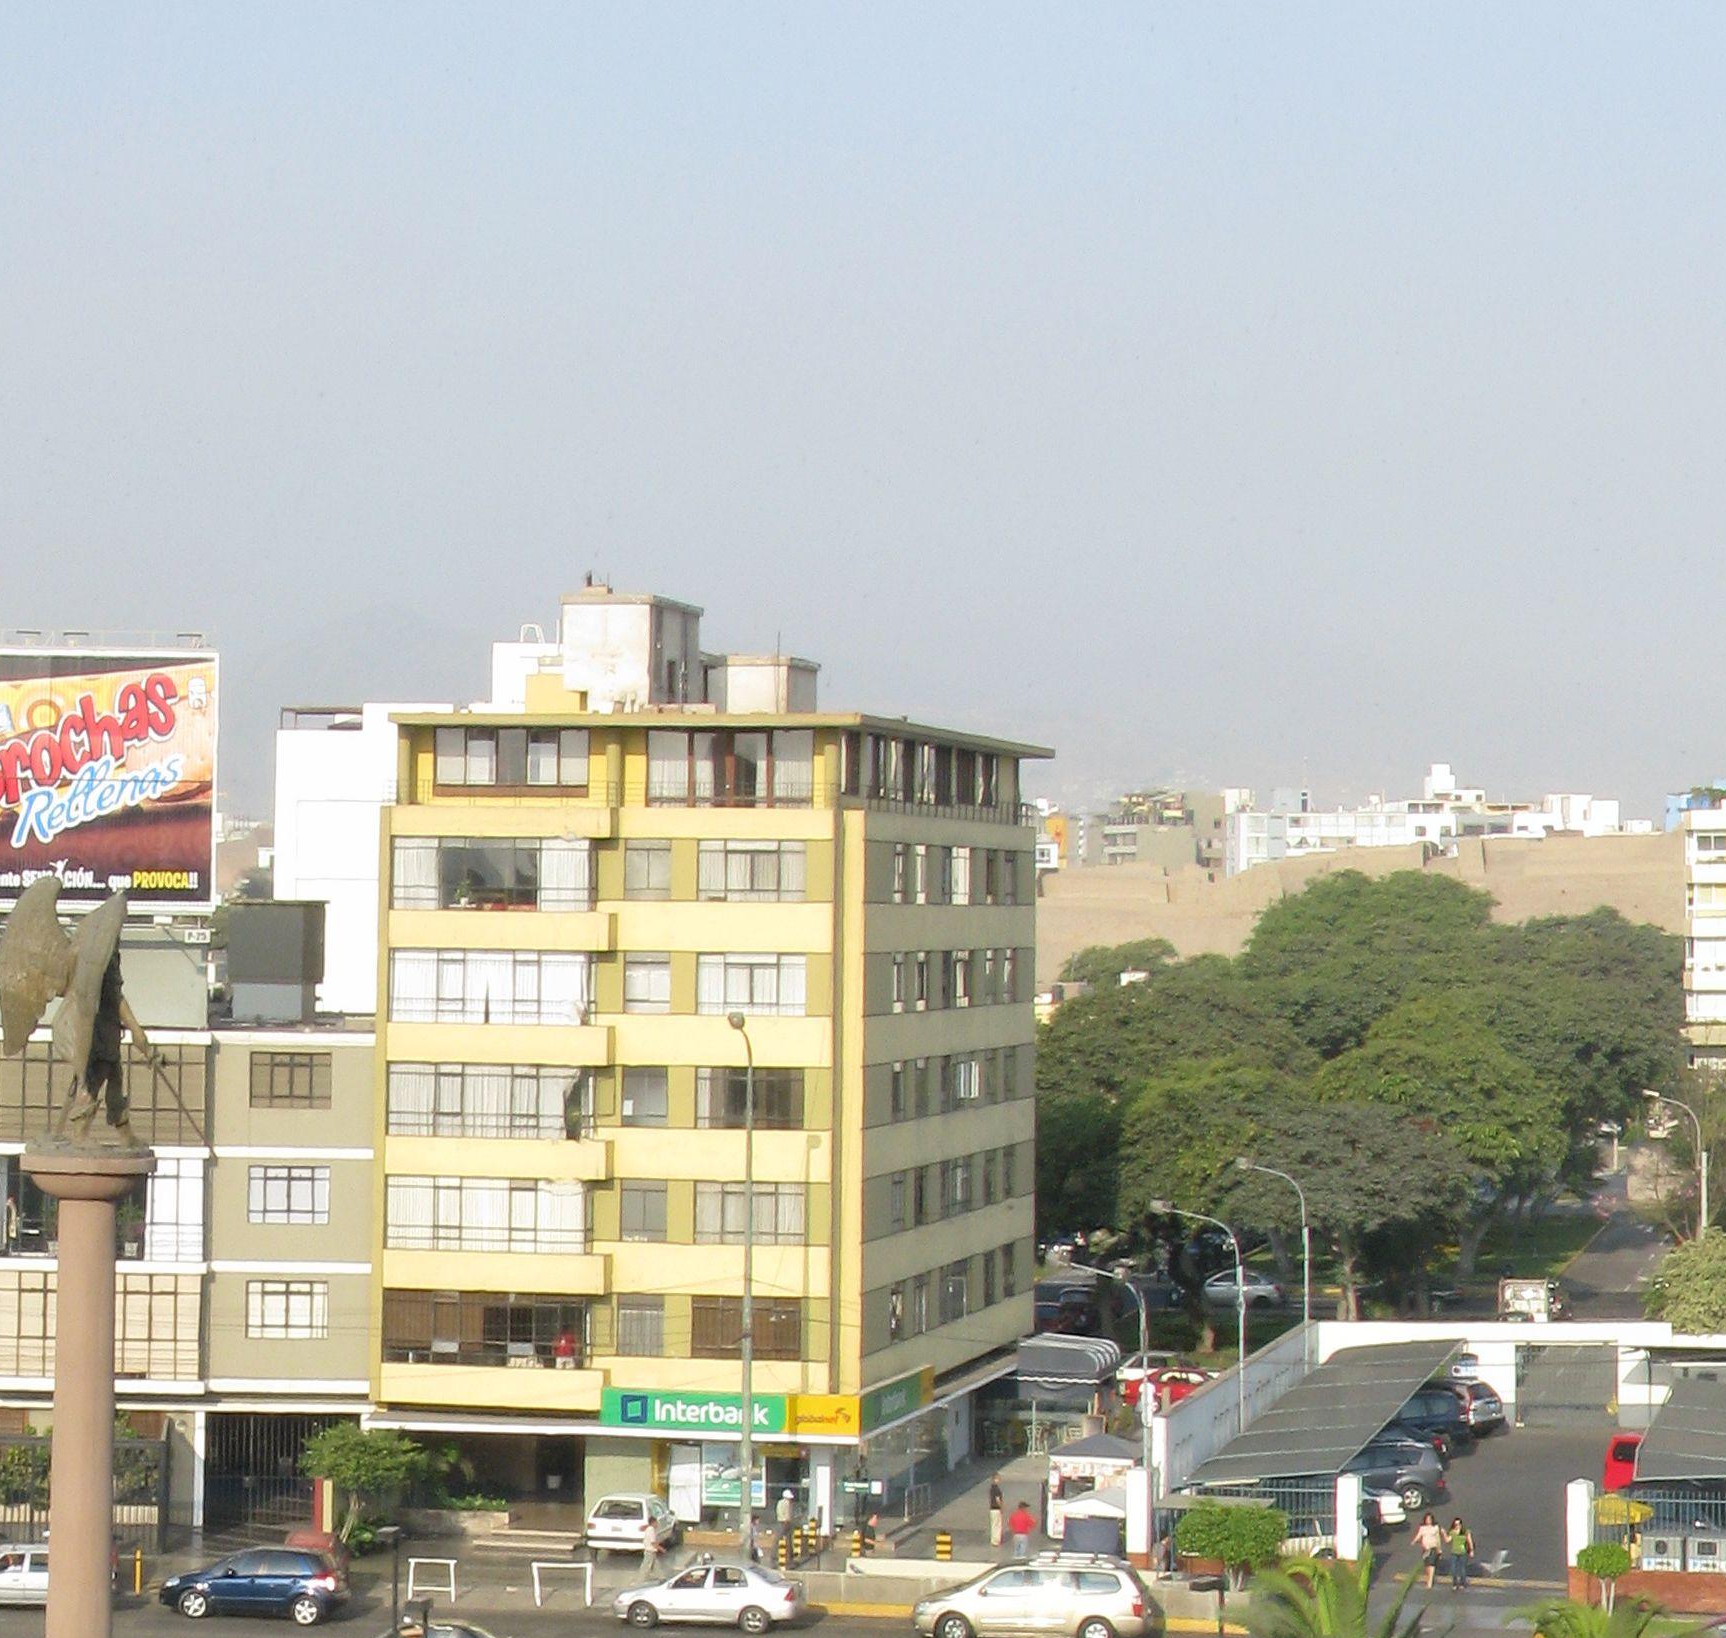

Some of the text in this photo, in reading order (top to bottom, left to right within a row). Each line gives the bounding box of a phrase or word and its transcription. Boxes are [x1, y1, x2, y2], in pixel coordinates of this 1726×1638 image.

[13, 755, 183, 845] Rellenas
[108, 873, 131, 892] que
[132, 871, 198, 889] PROVOCA!!
